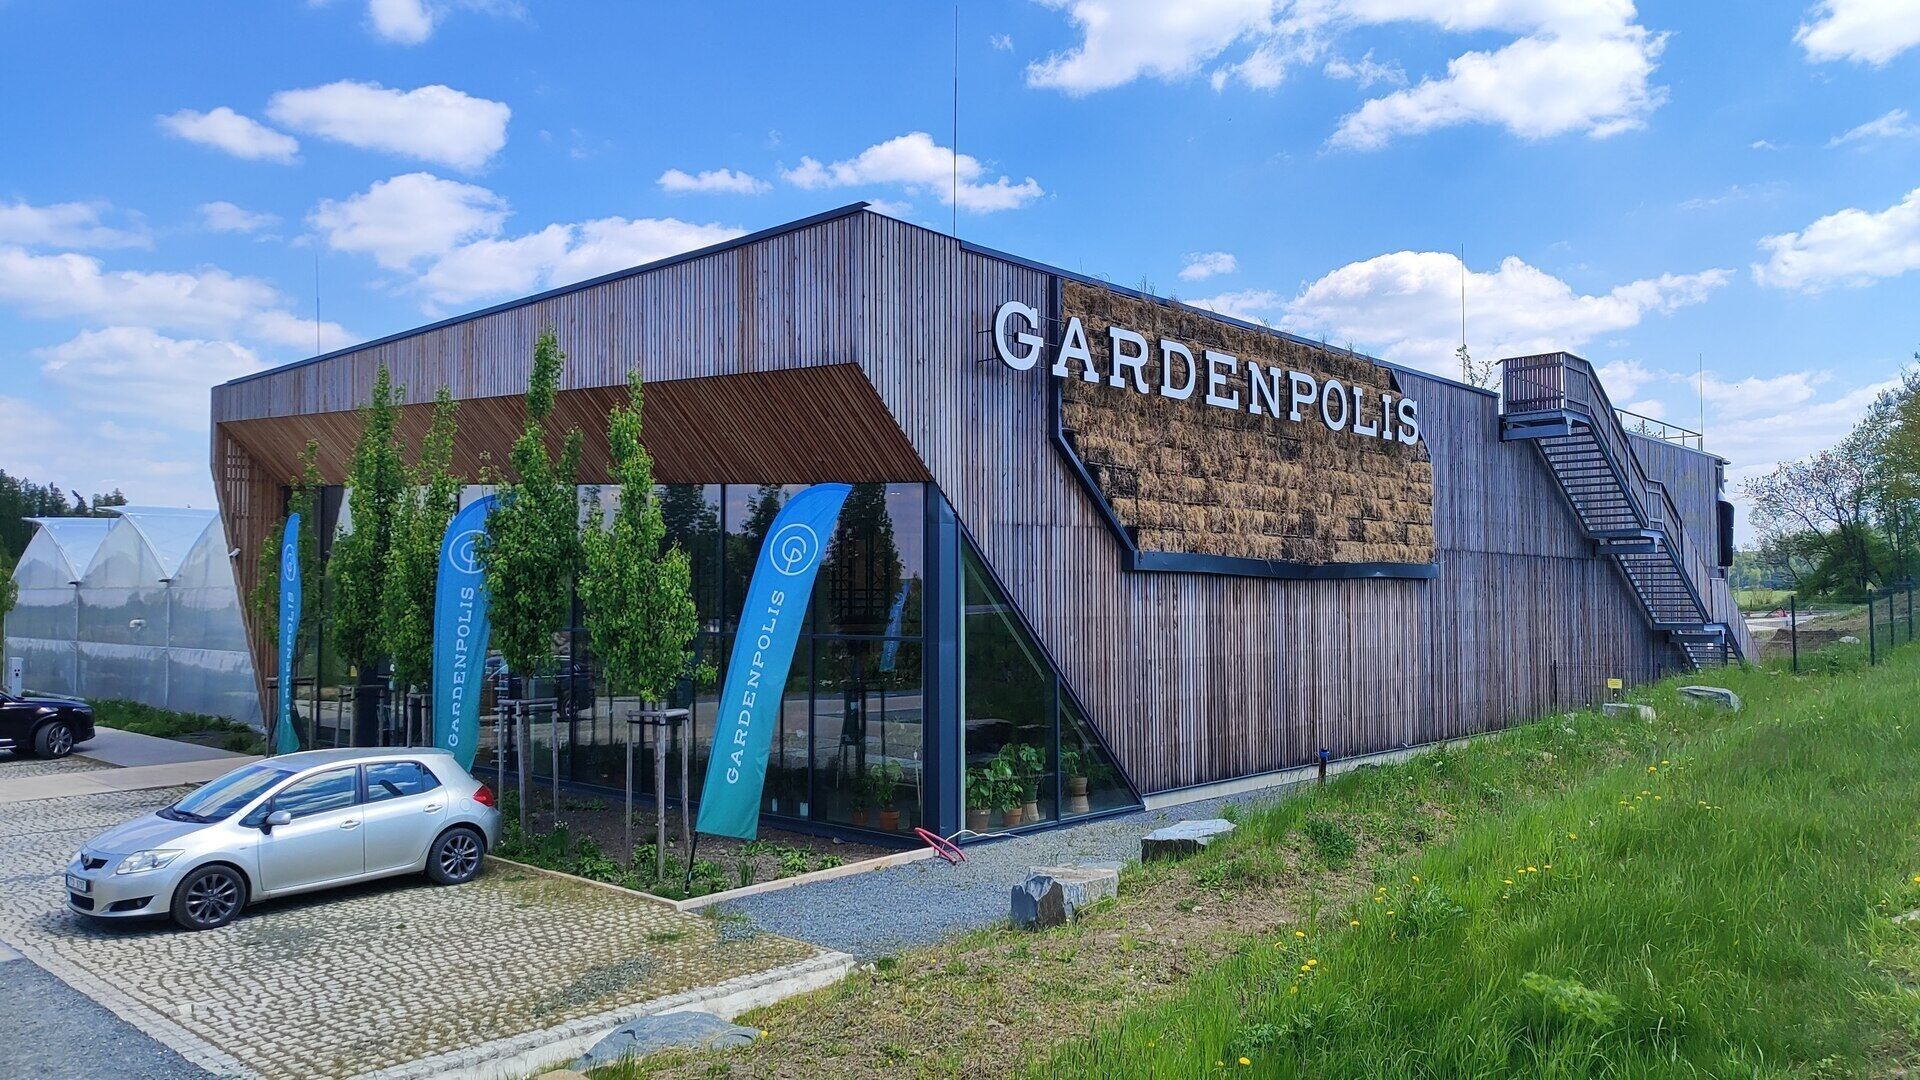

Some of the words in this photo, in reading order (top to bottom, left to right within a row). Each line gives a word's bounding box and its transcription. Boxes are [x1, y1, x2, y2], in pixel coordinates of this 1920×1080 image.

[994, 300, 1420, 446] GARDENPOLIS
[447, 586, 475, 747] GARDENPOLIS
[727, 589, 785, 784] GARDENPOLIS
